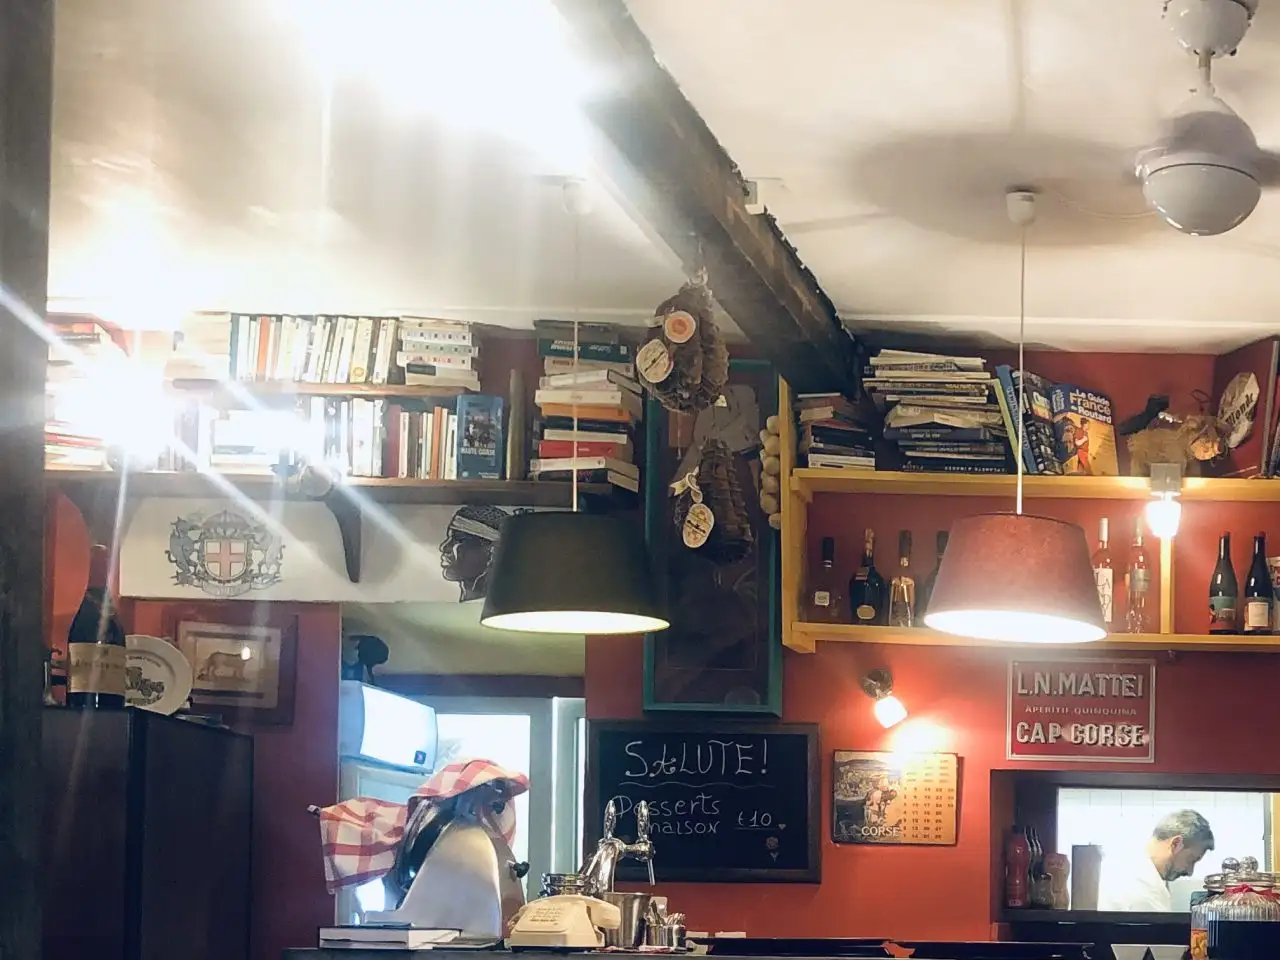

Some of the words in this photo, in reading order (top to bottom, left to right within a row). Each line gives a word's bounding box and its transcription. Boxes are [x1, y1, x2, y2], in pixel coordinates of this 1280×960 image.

[1017, 671, 1144, 697] L.N.MATTEI
[1016, 721, 1061, 744] CAP
[1071, 723, 1146, 748] CORSE
